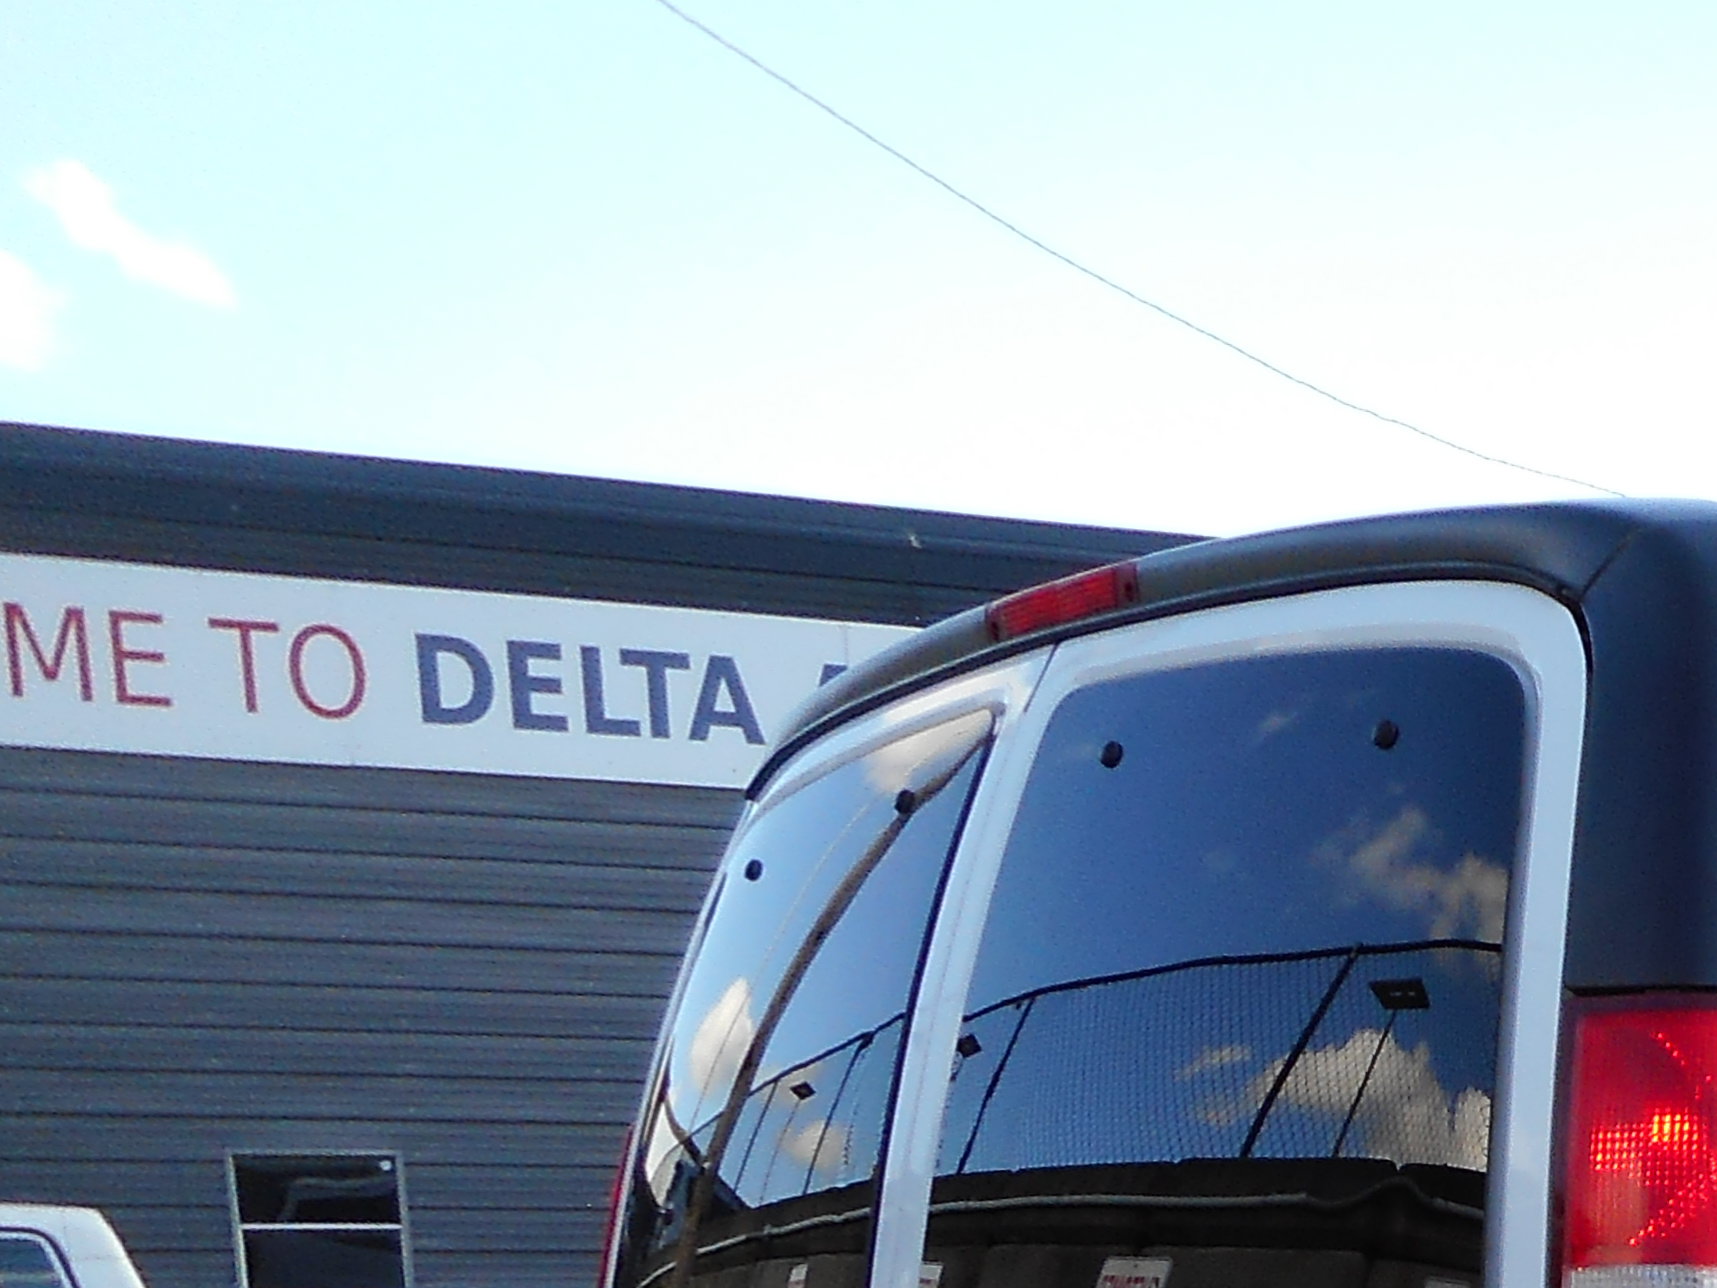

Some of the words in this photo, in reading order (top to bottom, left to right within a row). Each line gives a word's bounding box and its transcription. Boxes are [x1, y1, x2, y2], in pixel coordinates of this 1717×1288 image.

[3, 604, 173, 708] ME
[208, 617, 370, 721] TO
[415, 632, 766, 747] DELTA
